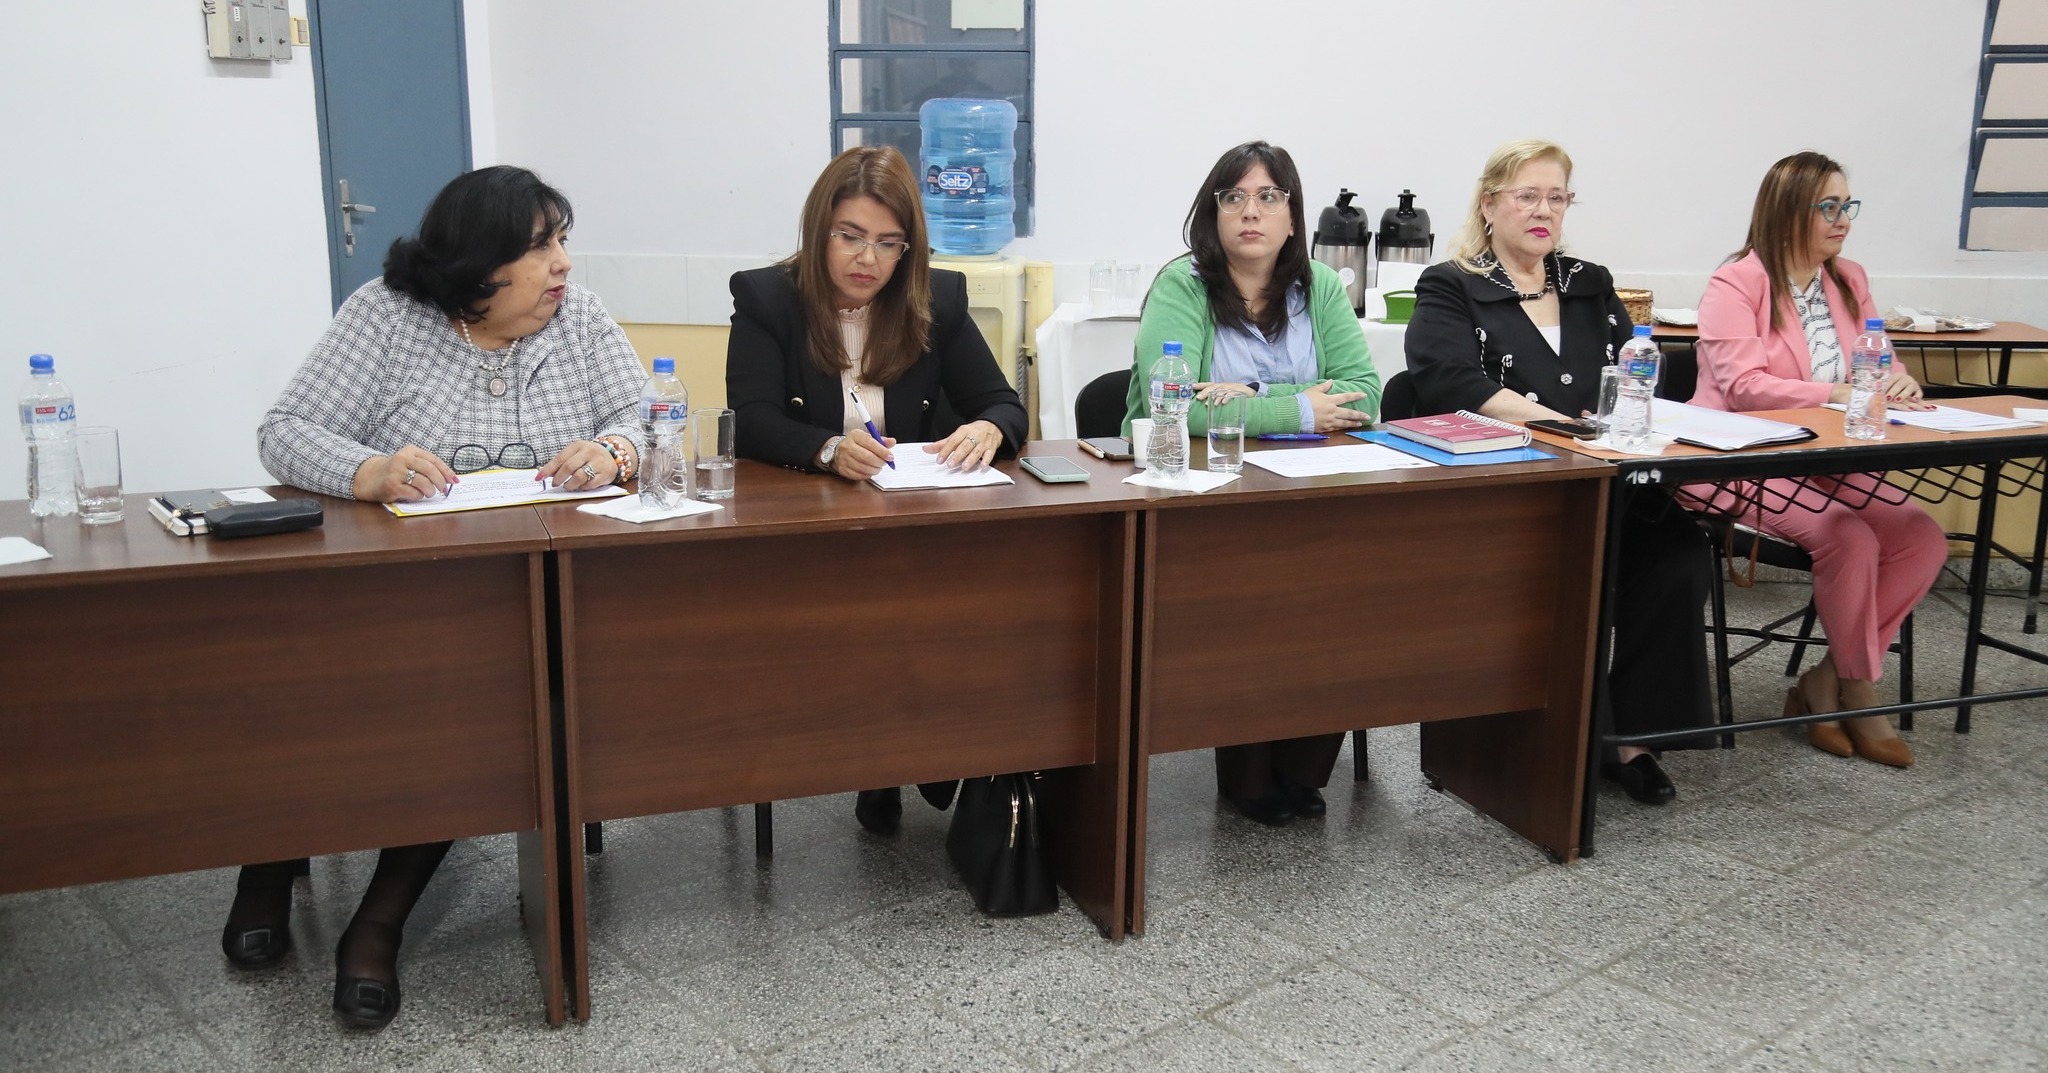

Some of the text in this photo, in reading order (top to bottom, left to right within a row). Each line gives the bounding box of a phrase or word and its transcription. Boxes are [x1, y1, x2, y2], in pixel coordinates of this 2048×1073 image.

[940, 174, 970, 188] Seltz
[670, 404, 687, 420] 62
[1625, 468, 1662, 485] 109
